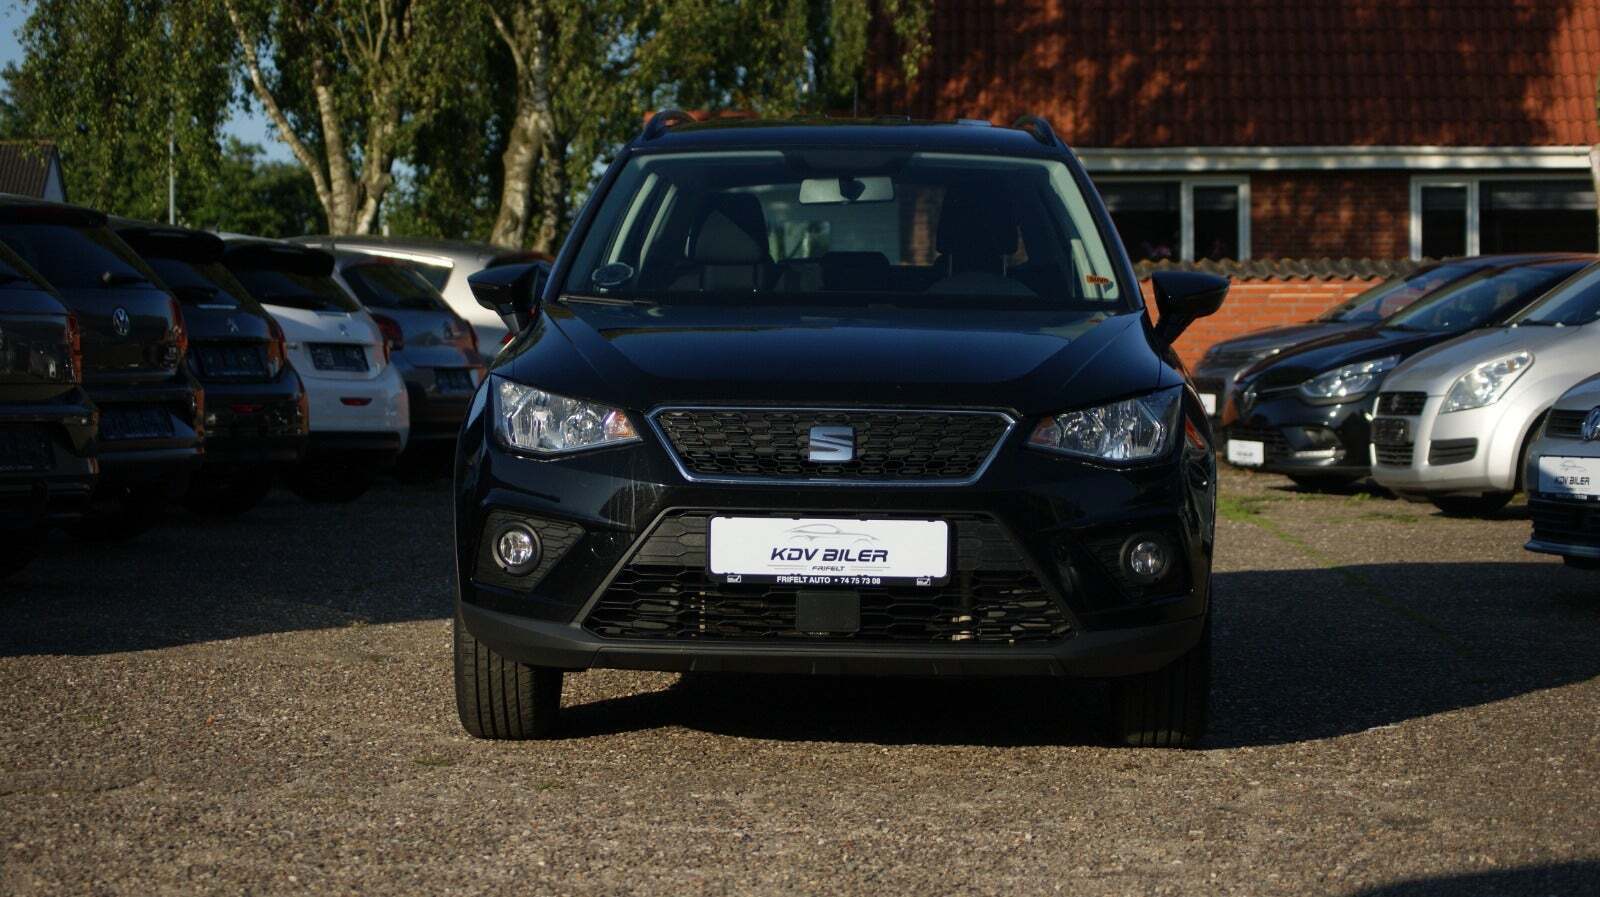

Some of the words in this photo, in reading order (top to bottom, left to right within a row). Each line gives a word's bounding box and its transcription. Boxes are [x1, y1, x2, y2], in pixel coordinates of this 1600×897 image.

[1569, 476, 1590, 485] BILER
[770, 547, 819, 561] KDV
[822, 548, 889, 562] BILER
[776, 576, 807, 584] FRIFELT
[809, 576, 831, 584] AUTO
